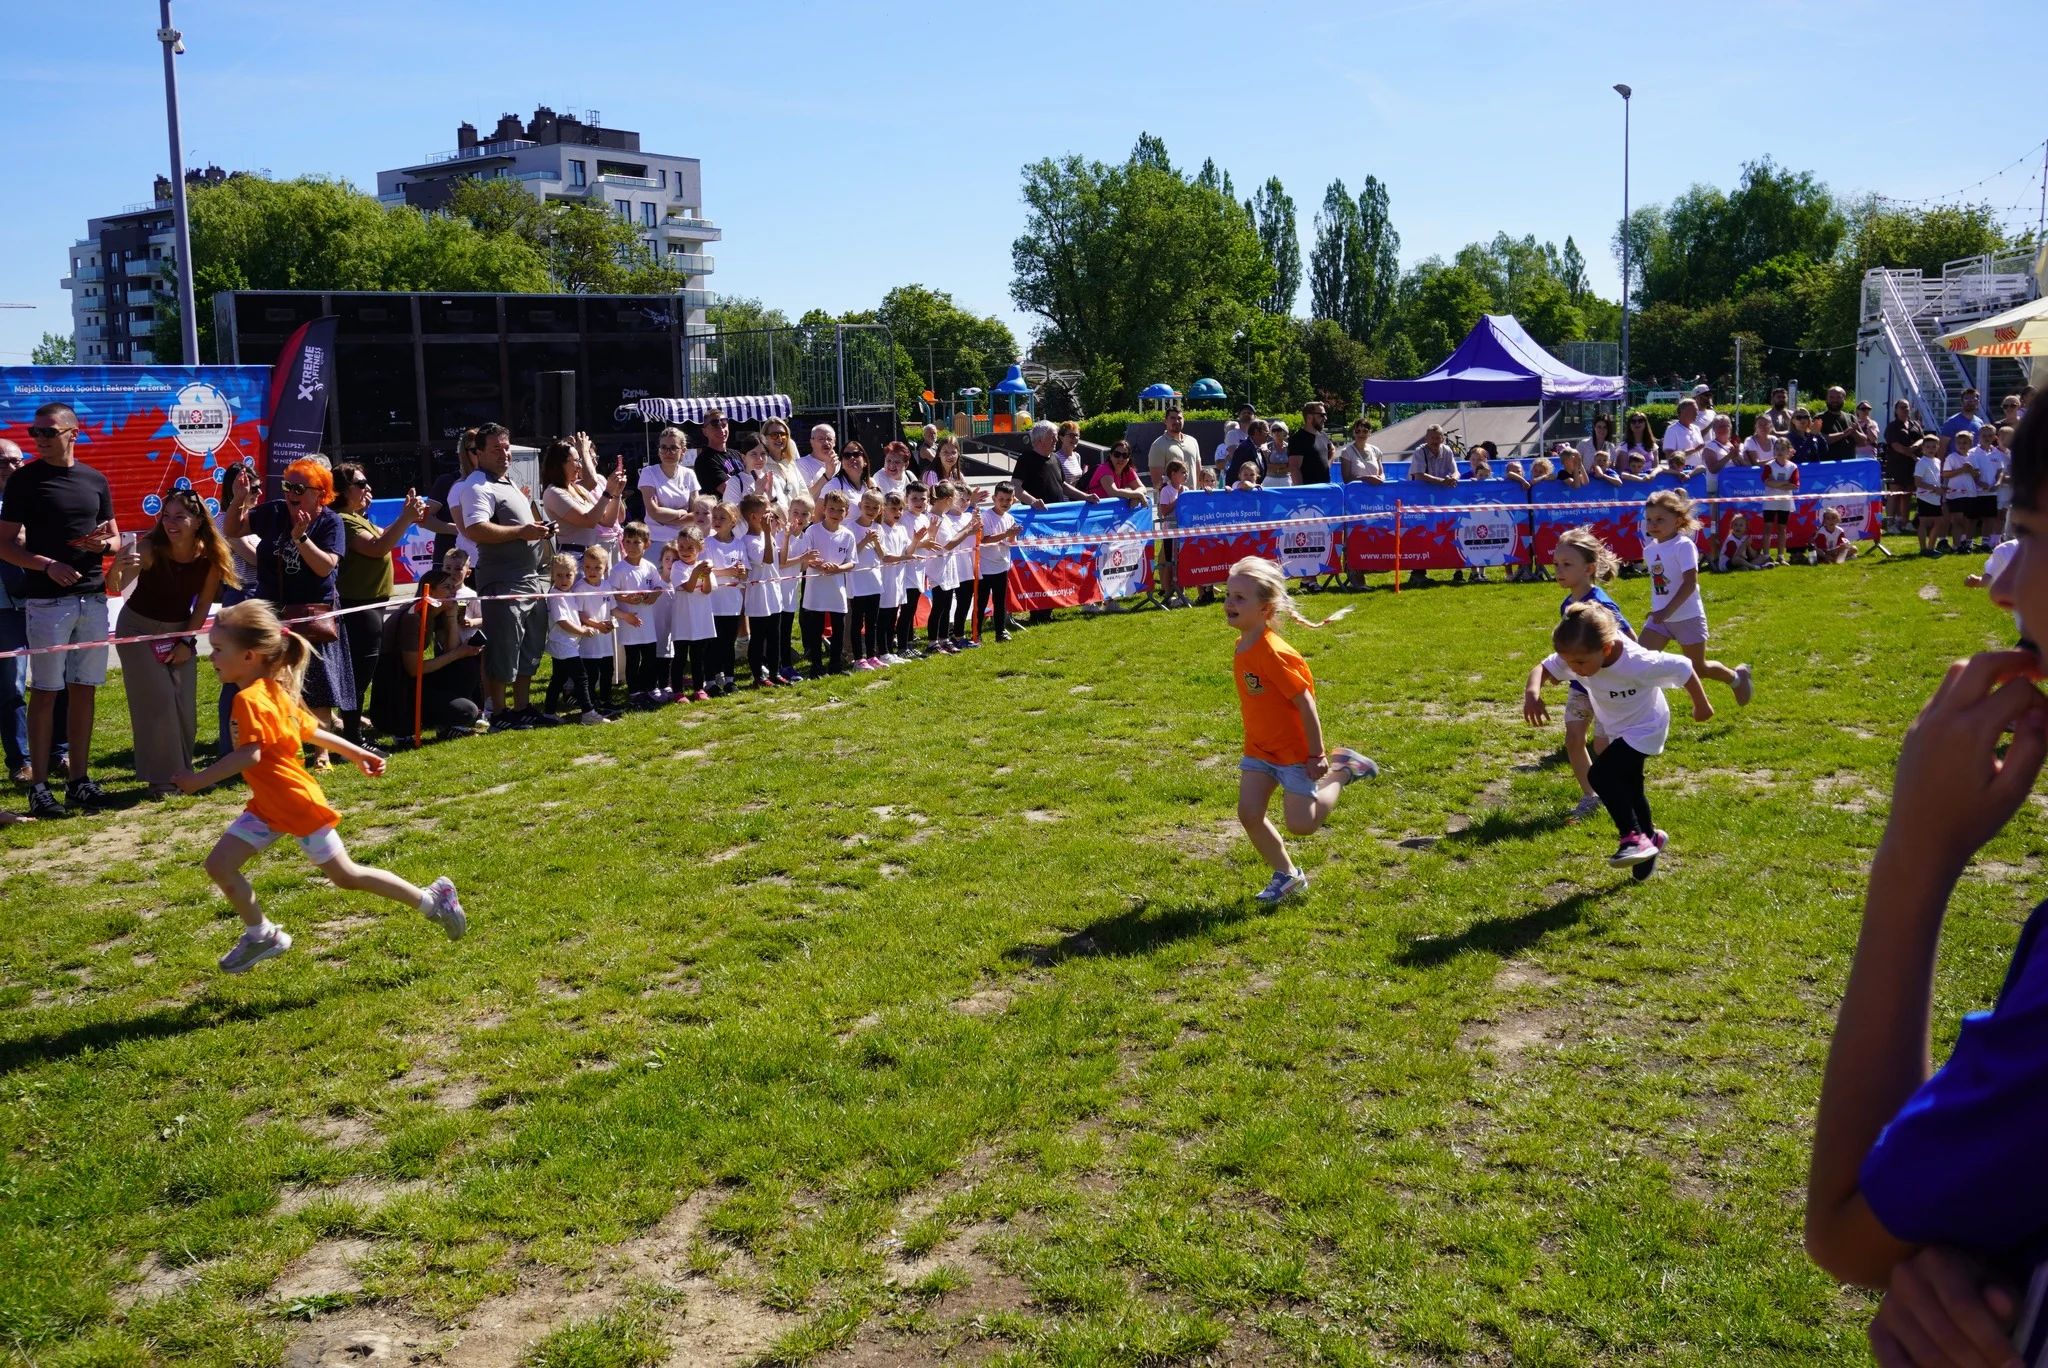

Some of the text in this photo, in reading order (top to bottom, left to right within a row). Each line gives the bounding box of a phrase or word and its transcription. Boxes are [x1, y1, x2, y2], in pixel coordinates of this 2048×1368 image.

[312, 347, 321, 376] FITNESS
[298, 346, 314, 401] XTREME
[14, 385, 42, 393] Miejski
[42, 384, 74, 392] Ośrodek
[76, 385, 101, 393] Sportu
[106, 384, 139, 393] Rekreacji
[147, 383, 171, 391] Żorach
[178, 410, 223, 424] MOSiR
[1192, 512, 1214, 521] Miejski
[1464, 524, 1509, 539] MOSiR
[1284, 532, 1326, 547] MOSiR
